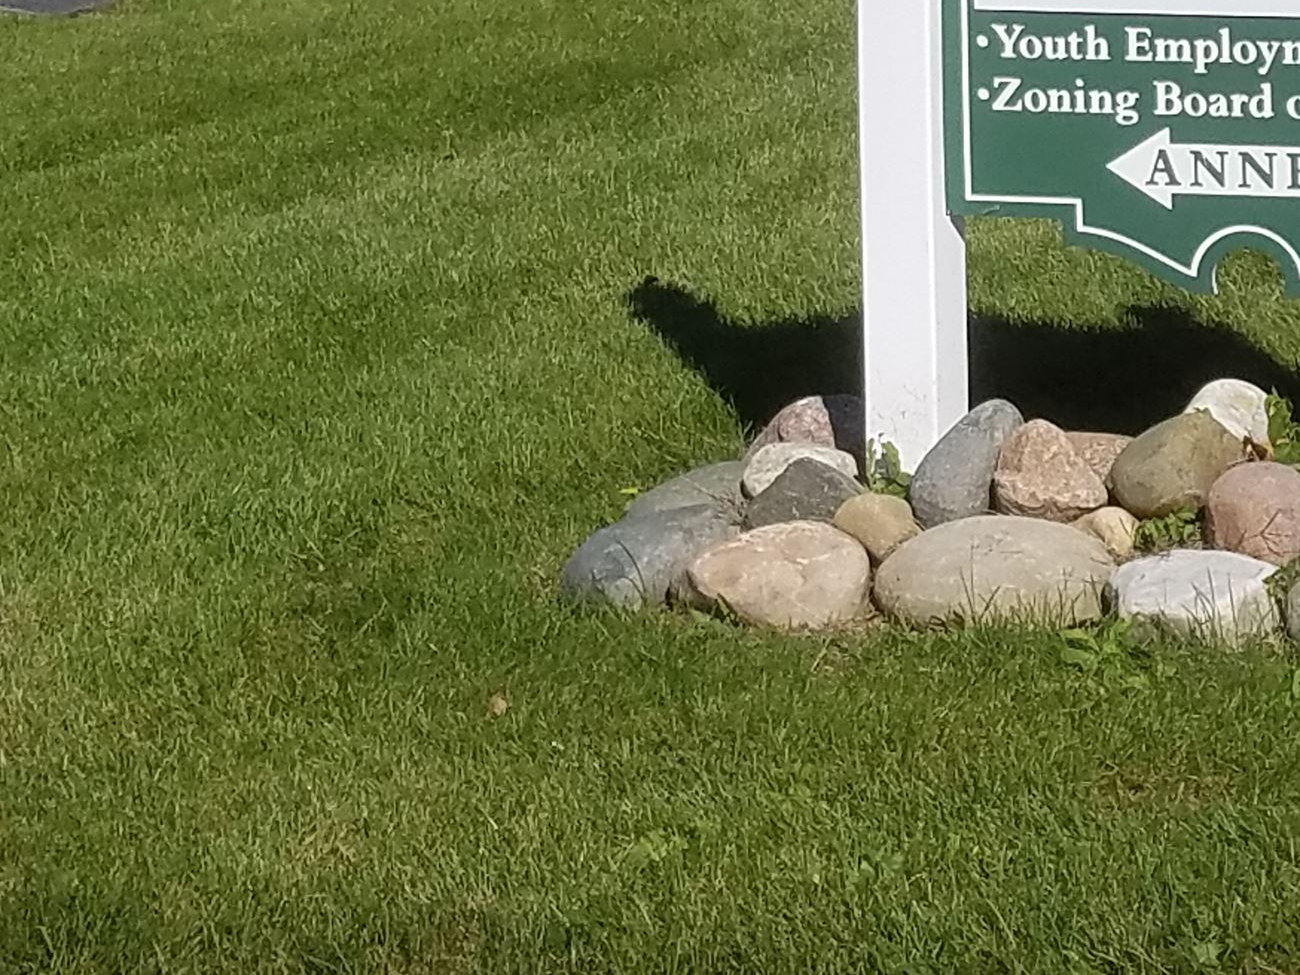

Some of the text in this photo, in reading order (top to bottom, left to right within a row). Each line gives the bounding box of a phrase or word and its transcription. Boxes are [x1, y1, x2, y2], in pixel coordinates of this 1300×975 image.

[990, 23, 1111, 61] Youth
[991, 76, 1140, 125] Zoning
[1153, 80, 1275, 120] Board
